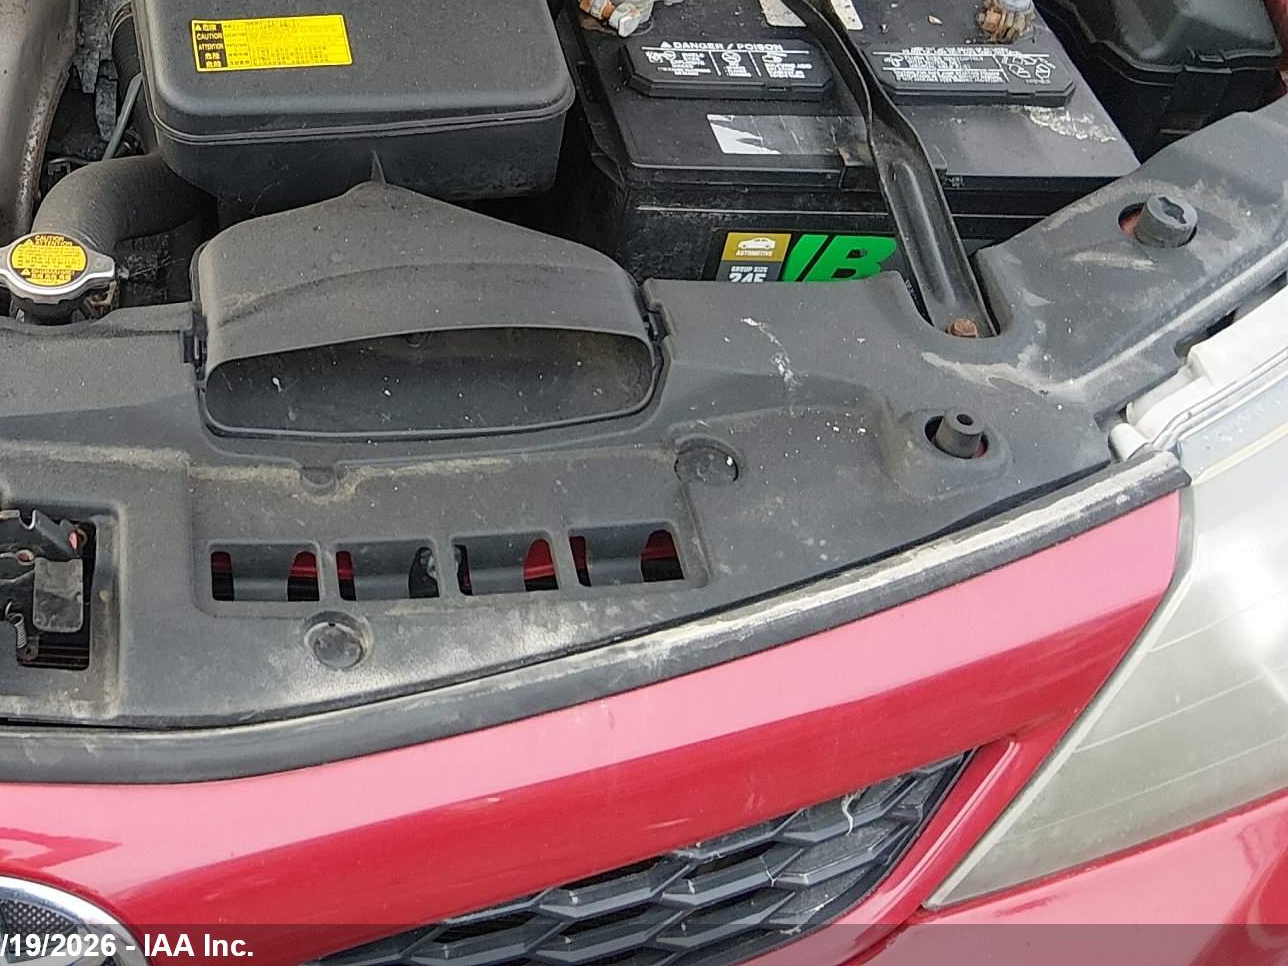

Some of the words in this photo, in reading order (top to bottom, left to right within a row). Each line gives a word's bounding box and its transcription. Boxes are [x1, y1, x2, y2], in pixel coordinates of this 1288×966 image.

[196, 32, 223, 41] CAUTION
[673, 41, 723, 50] DANGER
[736, 43, 783, 52] POISON
[735, 249, 774, 258] AUTOMOTIVE
[730, 265, 754, 273] GROUP
